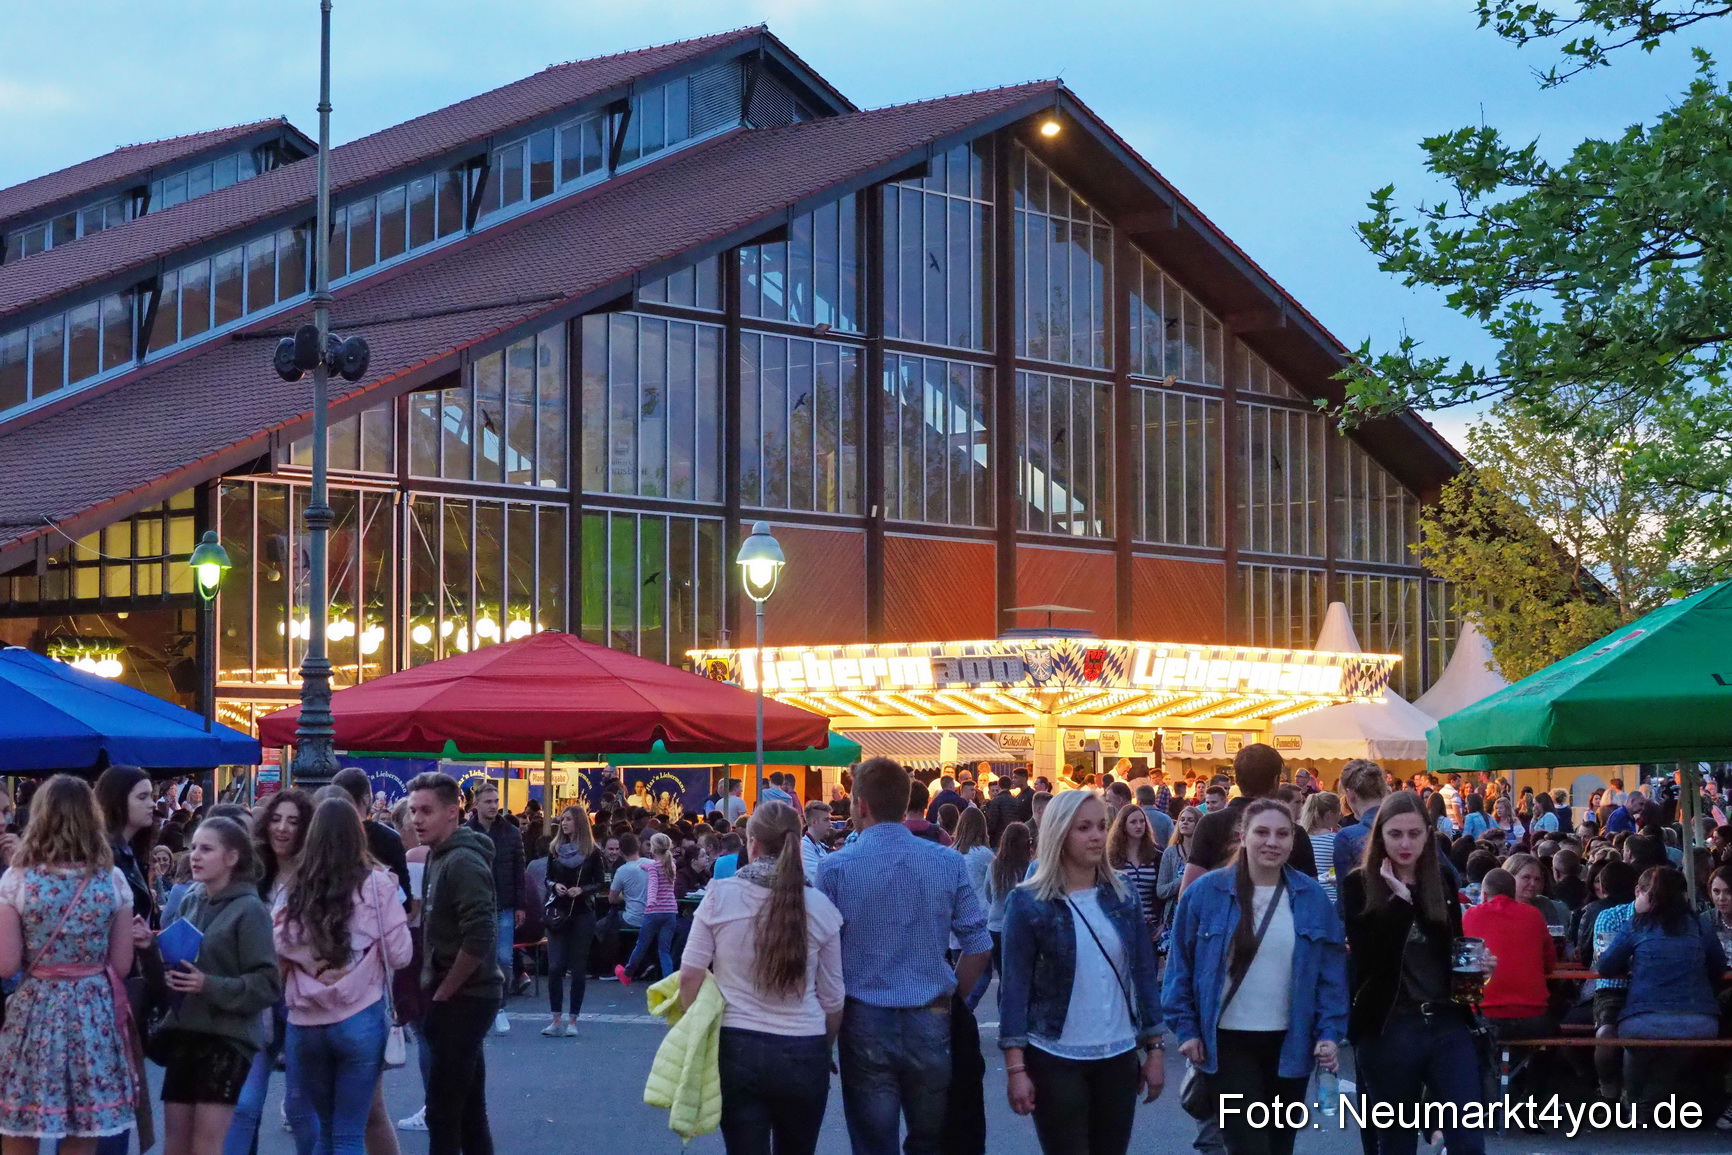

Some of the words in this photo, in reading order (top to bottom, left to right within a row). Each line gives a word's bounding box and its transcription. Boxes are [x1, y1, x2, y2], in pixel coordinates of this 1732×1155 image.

[740, 650, 1024, 689] Liebermann
[1132, 648, 1342, 693] Liebermann
[375, 770, 407, 793] Liebermann
[659, 771, 686, 793] Liebermann
